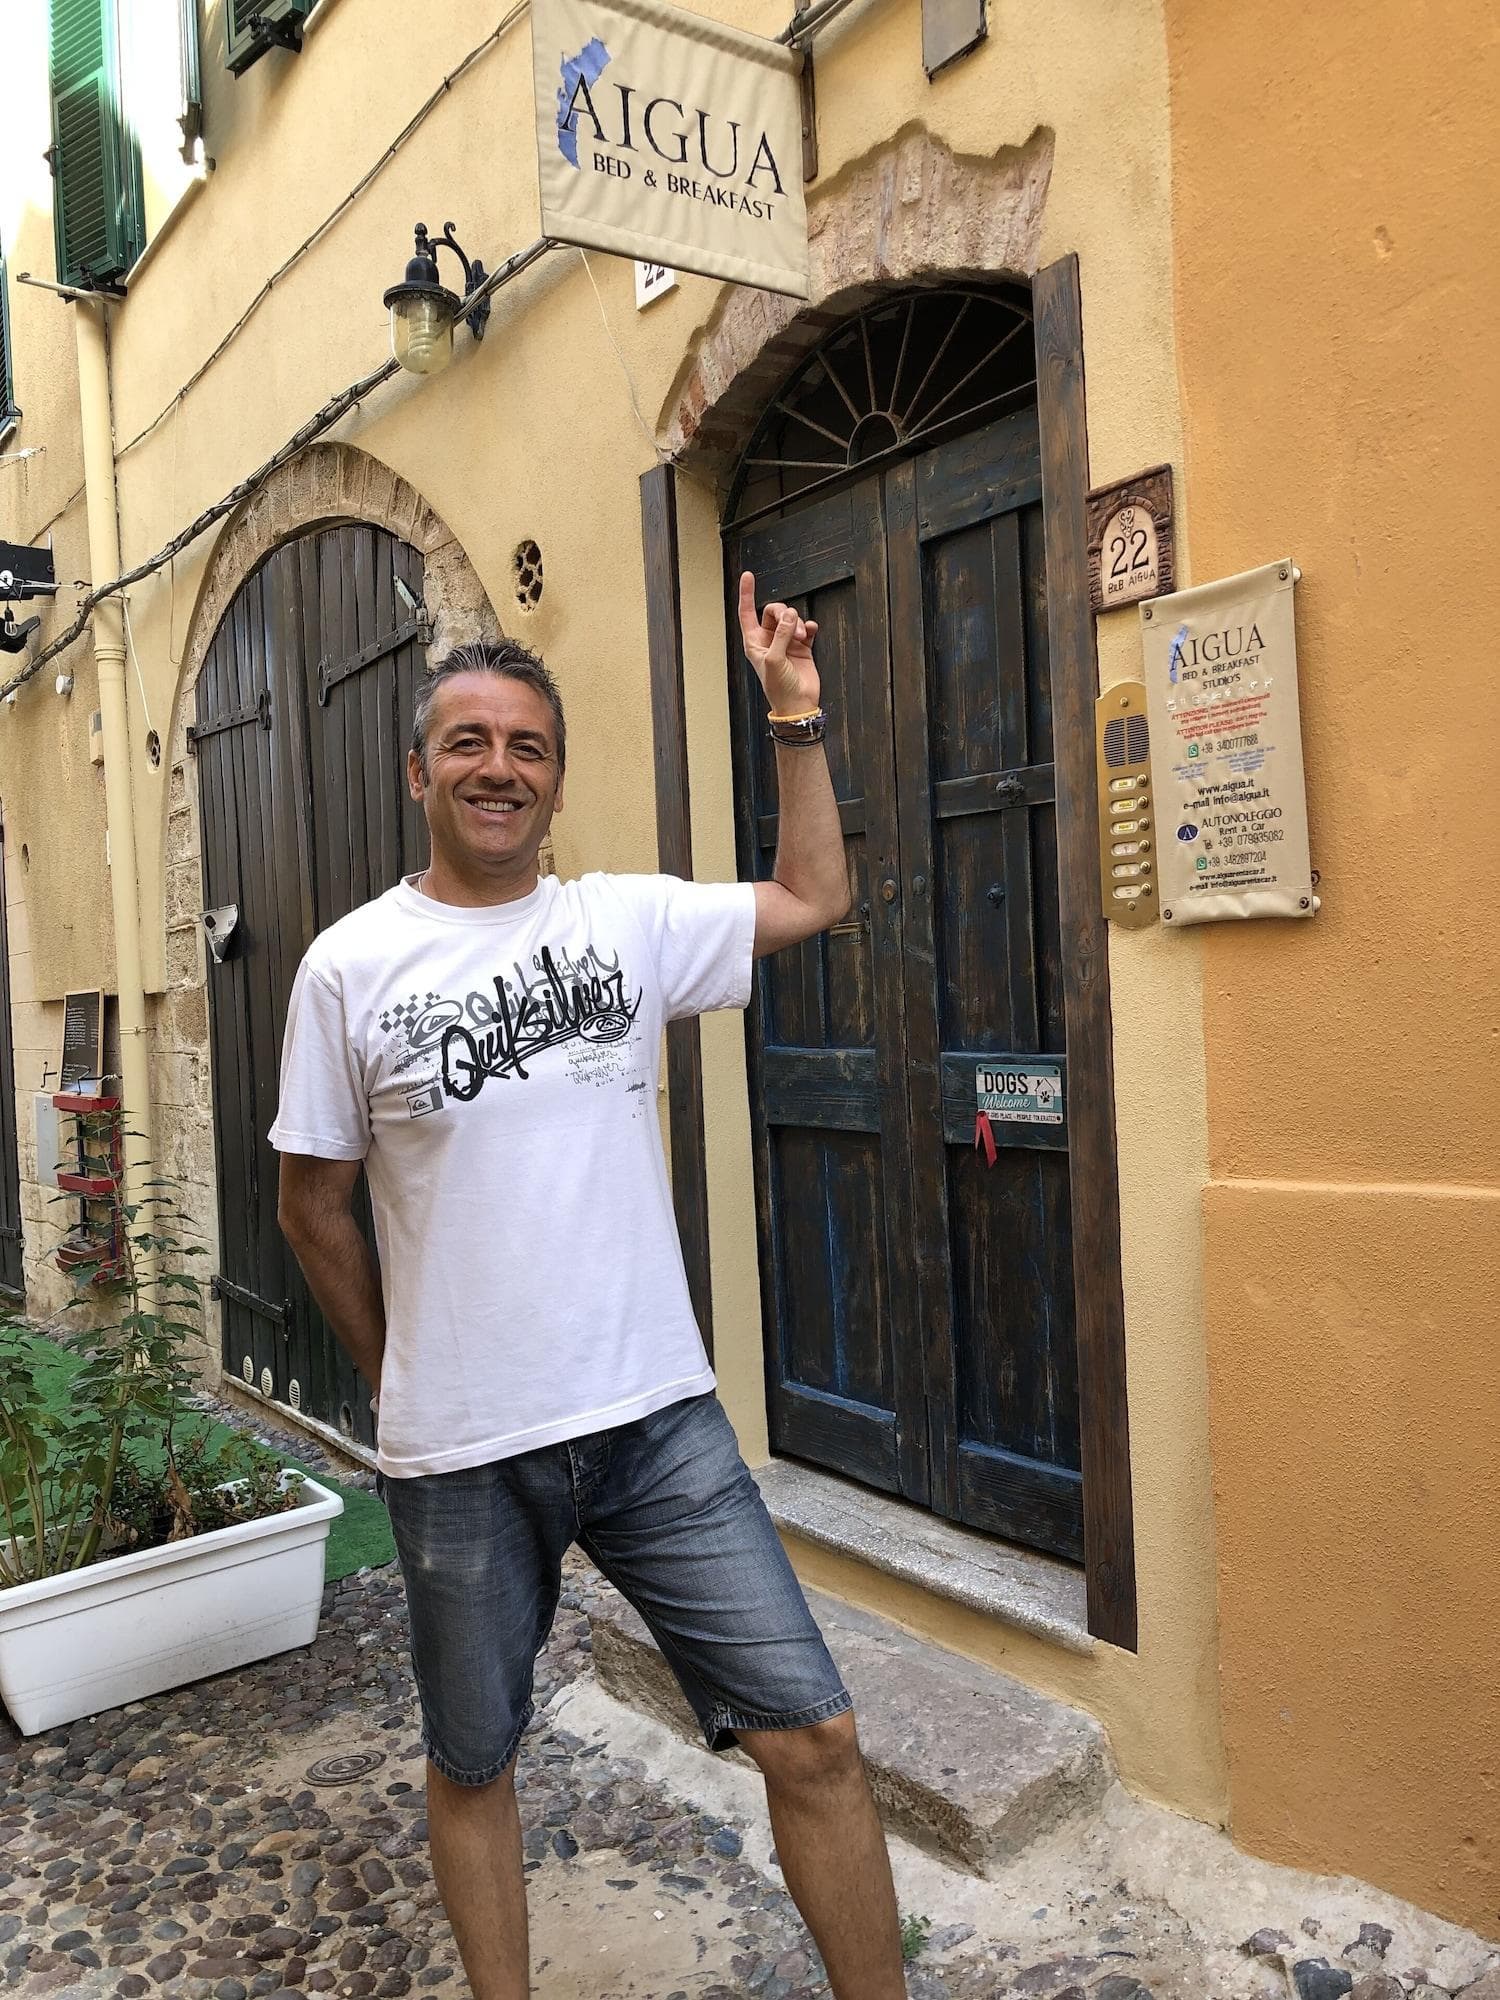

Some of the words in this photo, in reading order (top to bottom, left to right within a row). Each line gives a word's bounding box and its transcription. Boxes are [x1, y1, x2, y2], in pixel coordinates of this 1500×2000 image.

[559, 72, 789, 197] AIGUA
[593, 153, 631, 180] BED
[644, 169, 657, 188] &
[667, 173, 775, 221] BREAKFAST
[1110, 529, 1149, 579] 22
[1169, 623, 1267, 672] AIGUA
[1182, 670, 1198, 681] BED
[1202, 668, 1208, 676] &
[1212, 655, 1260, 674] BREAKFAST
[1203, 673, 1241, 690] STUDIO'S
[1198, 778, 1255, 796] www.aigua.it
[1183, 798, 1210, 810] e-mail
[1213, 788, 1270, 805] info@aigua.it
[1201, 807, 1282, 829] AUTONOLEGGIO
[1219, 827, 1238, 836] Rent
[1241, 825, 1247, 833] a
[1251, 823, 1265, 832] Car
[1217, 836, 1233, 848] +39
[441, 946, 643, 1101] Quiksilver
[984, 1071, 1028, 1094] DOGS
[982, 1094, 1032, 1110] Welcome
